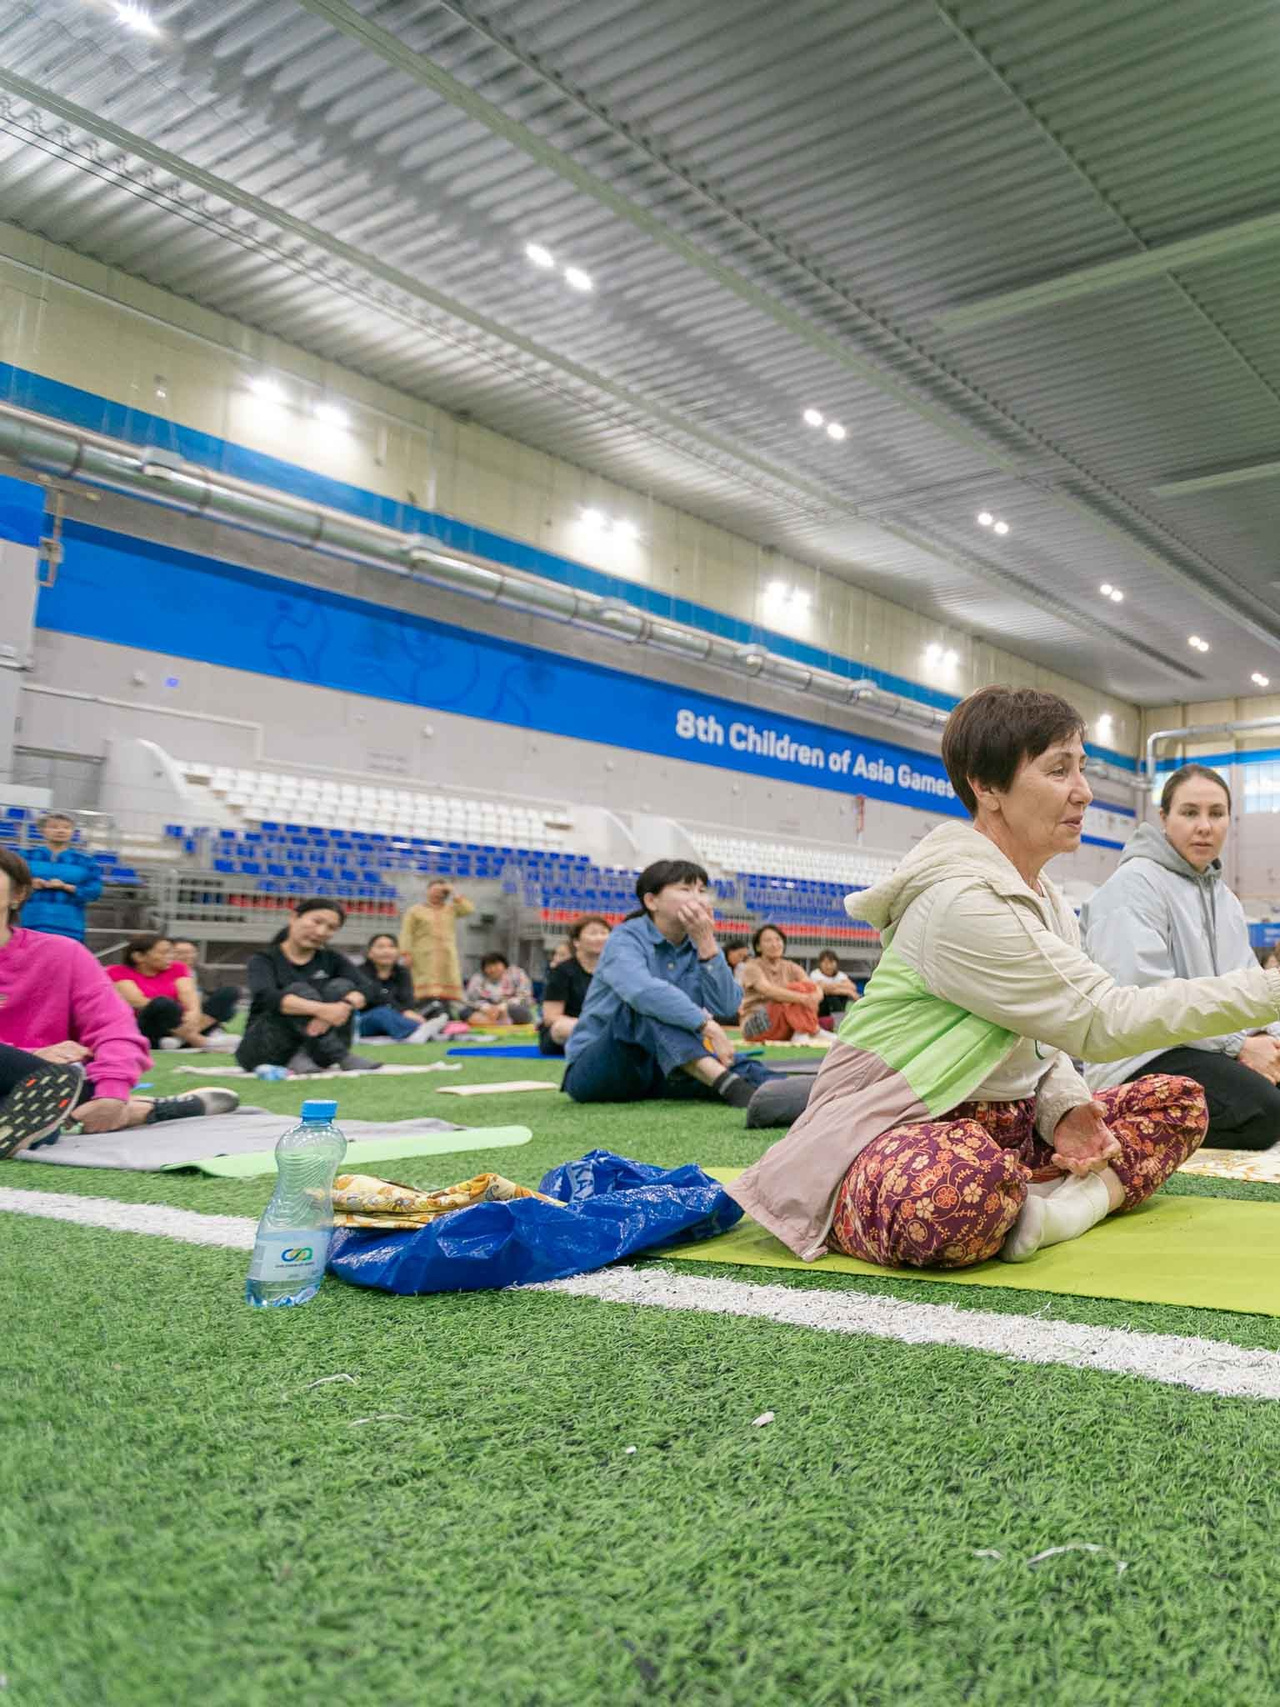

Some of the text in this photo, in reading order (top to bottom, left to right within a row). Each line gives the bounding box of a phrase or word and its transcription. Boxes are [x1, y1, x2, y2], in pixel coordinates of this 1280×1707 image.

[675, 709, 956, 799] 8th Children of Asia Games
